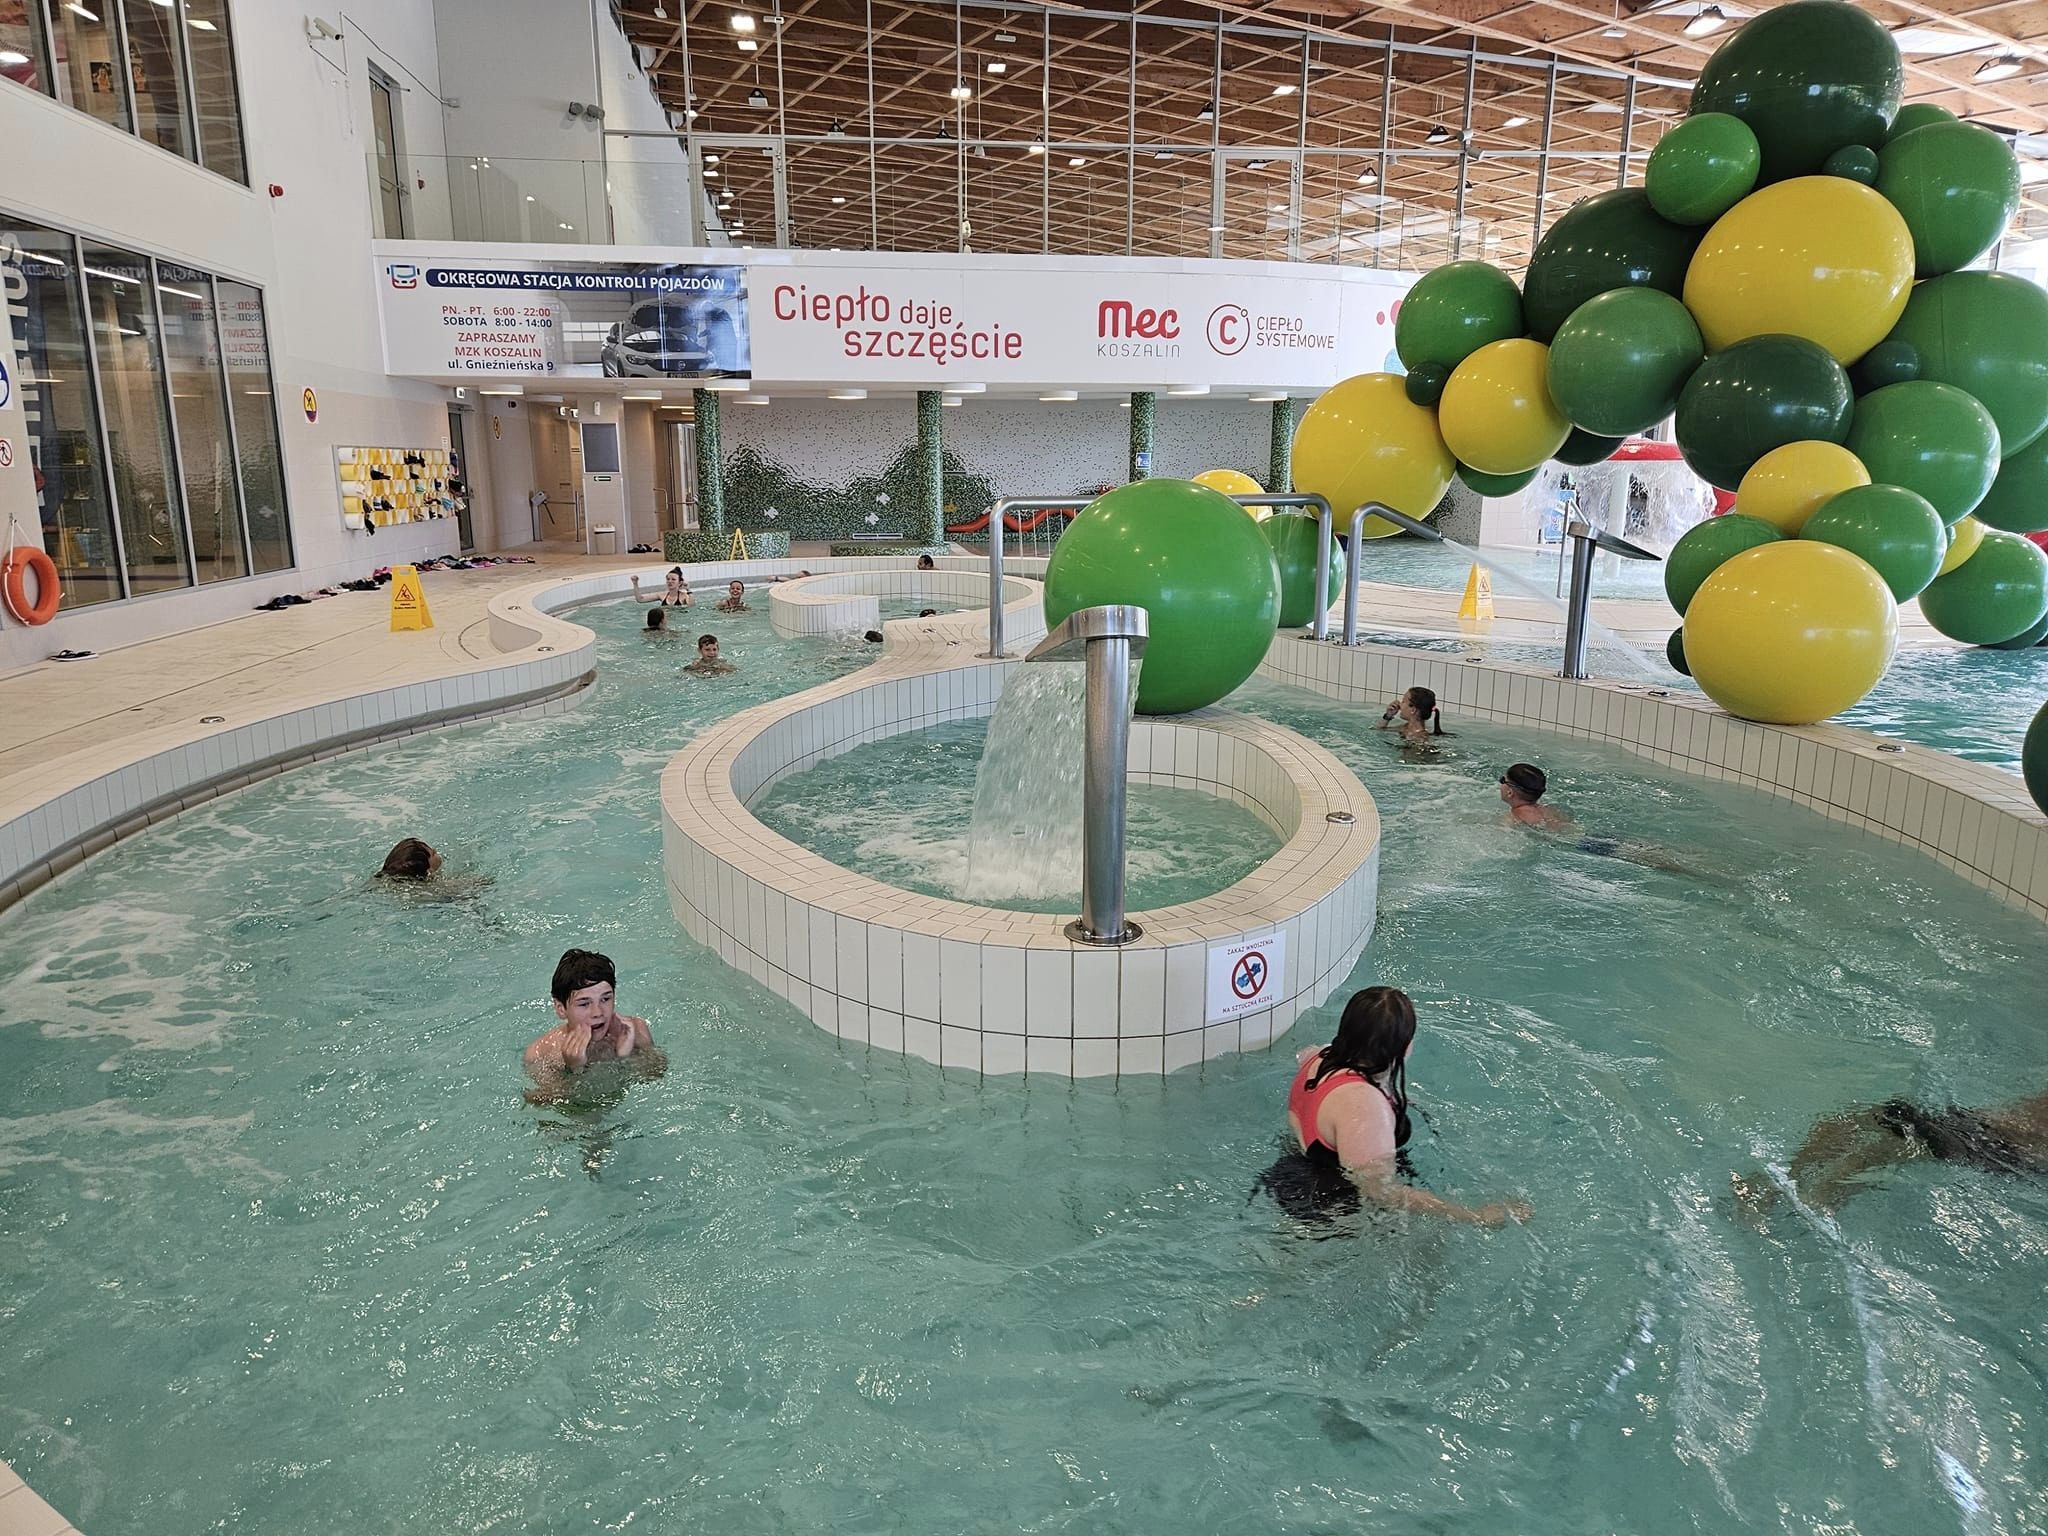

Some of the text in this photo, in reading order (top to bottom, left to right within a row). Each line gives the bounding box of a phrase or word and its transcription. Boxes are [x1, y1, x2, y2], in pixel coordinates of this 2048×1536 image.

[437, 271, 725, 292] OKRĘGOWA STACJA KONTROLI POJAZDÓW
[442, 305, 461, 315] PN.
[470, 306, 486, 316] PT.
[493, 307, 515, 316] 6:00
[523, 307, 551, 317] 22:00
[773, 284, 952, 330] Ciepło daje
[443, 316, 488, 327] SOBOTA
[495, 317, 517, 327] 8:00
[526, 318, 553, 328] 14:00
[1256, 316, 1303, 332] CIEPŁO
[458, 332, 536, 344] ZAPRASZAMY
[844, 321, 1023, 365] szczęście
[1256, 333, 1335, 349] SYSTEMOWE
[455, 346, 542, 358] MZK KOSZALIN
[447, 359, 554, 371] ul. Gnieźnieńska 9
[1227, 946, 1245, 955] ZAKAZ
